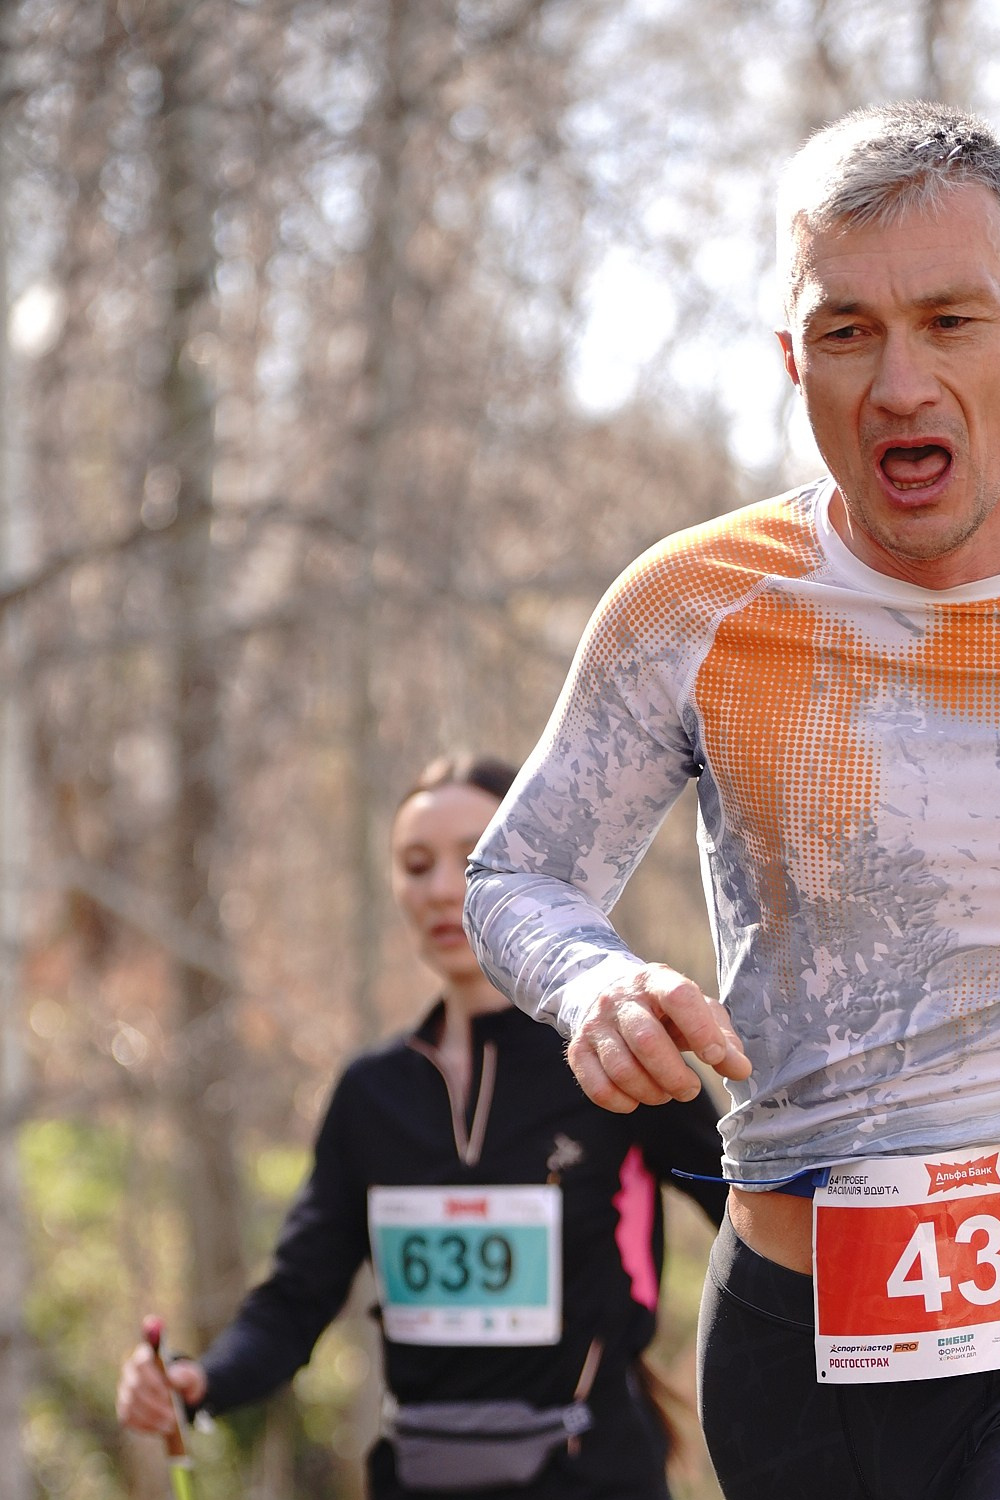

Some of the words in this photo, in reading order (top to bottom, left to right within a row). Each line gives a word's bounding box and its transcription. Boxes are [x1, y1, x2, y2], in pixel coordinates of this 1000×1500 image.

[841, 1175, 868, 1185] ПРОБЕГ
[936, 1169, 968, 1184] Альфа
[968, 1167, 993, 1178] Банк
[827, 1186, 861, 1195] ВАСИЛИЯ
[400, 1233, 513, 1294] 639
[937, 1334, 975, 1347] СИБУР
[893, 1342, 918, 1352] PRO
[938, 1345, 976, 1356] ФОРМУЛА
[829, 1358, 890, 1368] РОСГОССТРАХ
